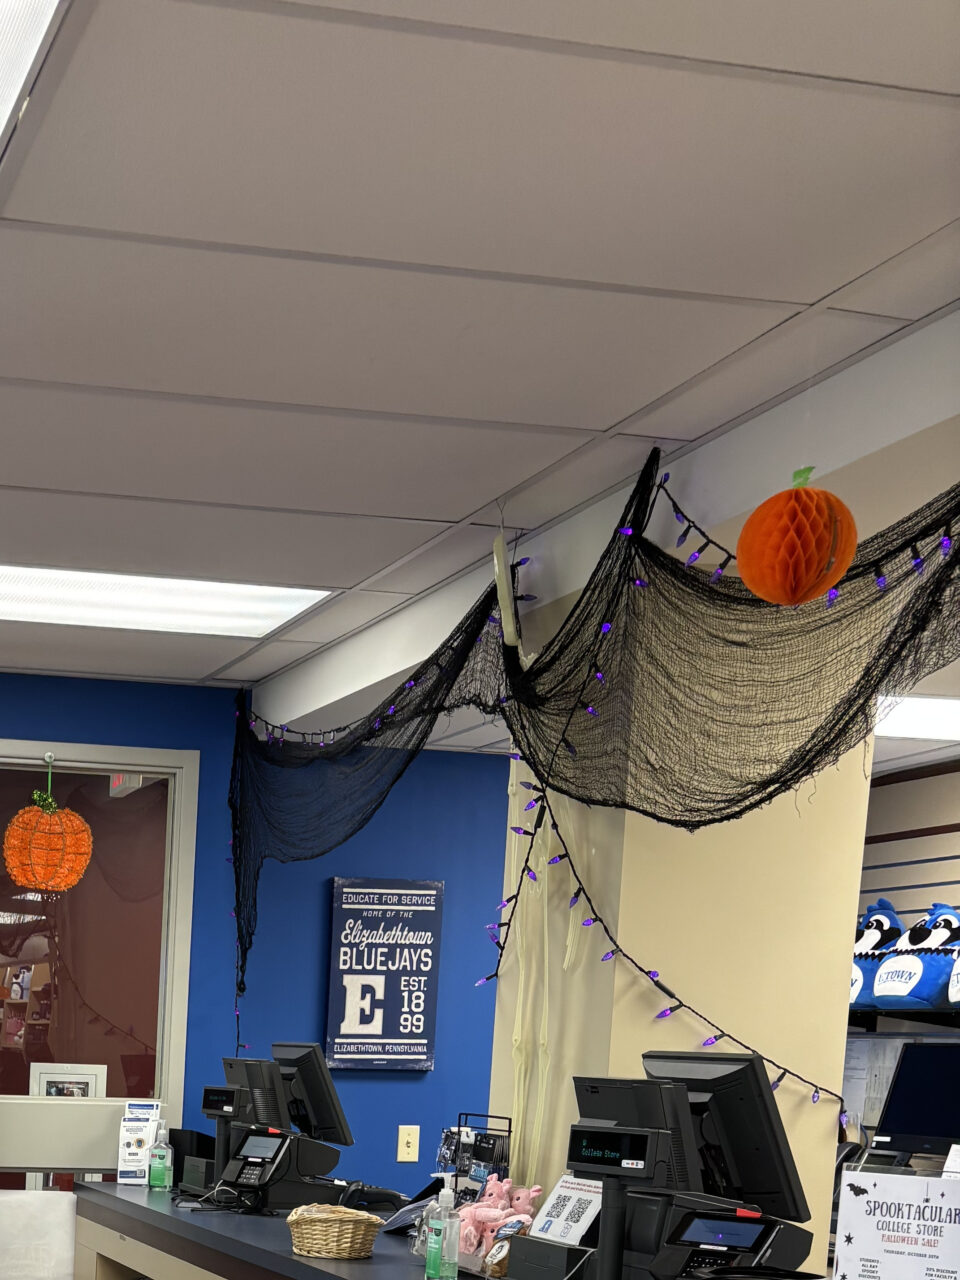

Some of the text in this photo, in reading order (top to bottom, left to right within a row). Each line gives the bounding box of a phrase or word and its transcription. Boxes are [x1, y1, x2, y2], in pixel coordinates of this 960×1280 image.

[342, 894, 436, 905] EDUCATE FOR SERVICE
[362, 910, 383, 918] HOME
[341, 919, 434, 950] Elizabethtown
[401, 976, 428, 991] EST.
[340, 974, 386, 1035] E
[401, 991, 425, 1013] 18
[400, 1014, 425, 1034] 99
[334, 1044, 428, 1053] ELIZABETHTOWN, PENNSYLVANIA
[865, 1200, 960, 1225] SPOOKTACULAR
[876, 1219, 945, 1238] COLLEGE STORE
[881, 1233, 919, 1246] HALLOWEEN
